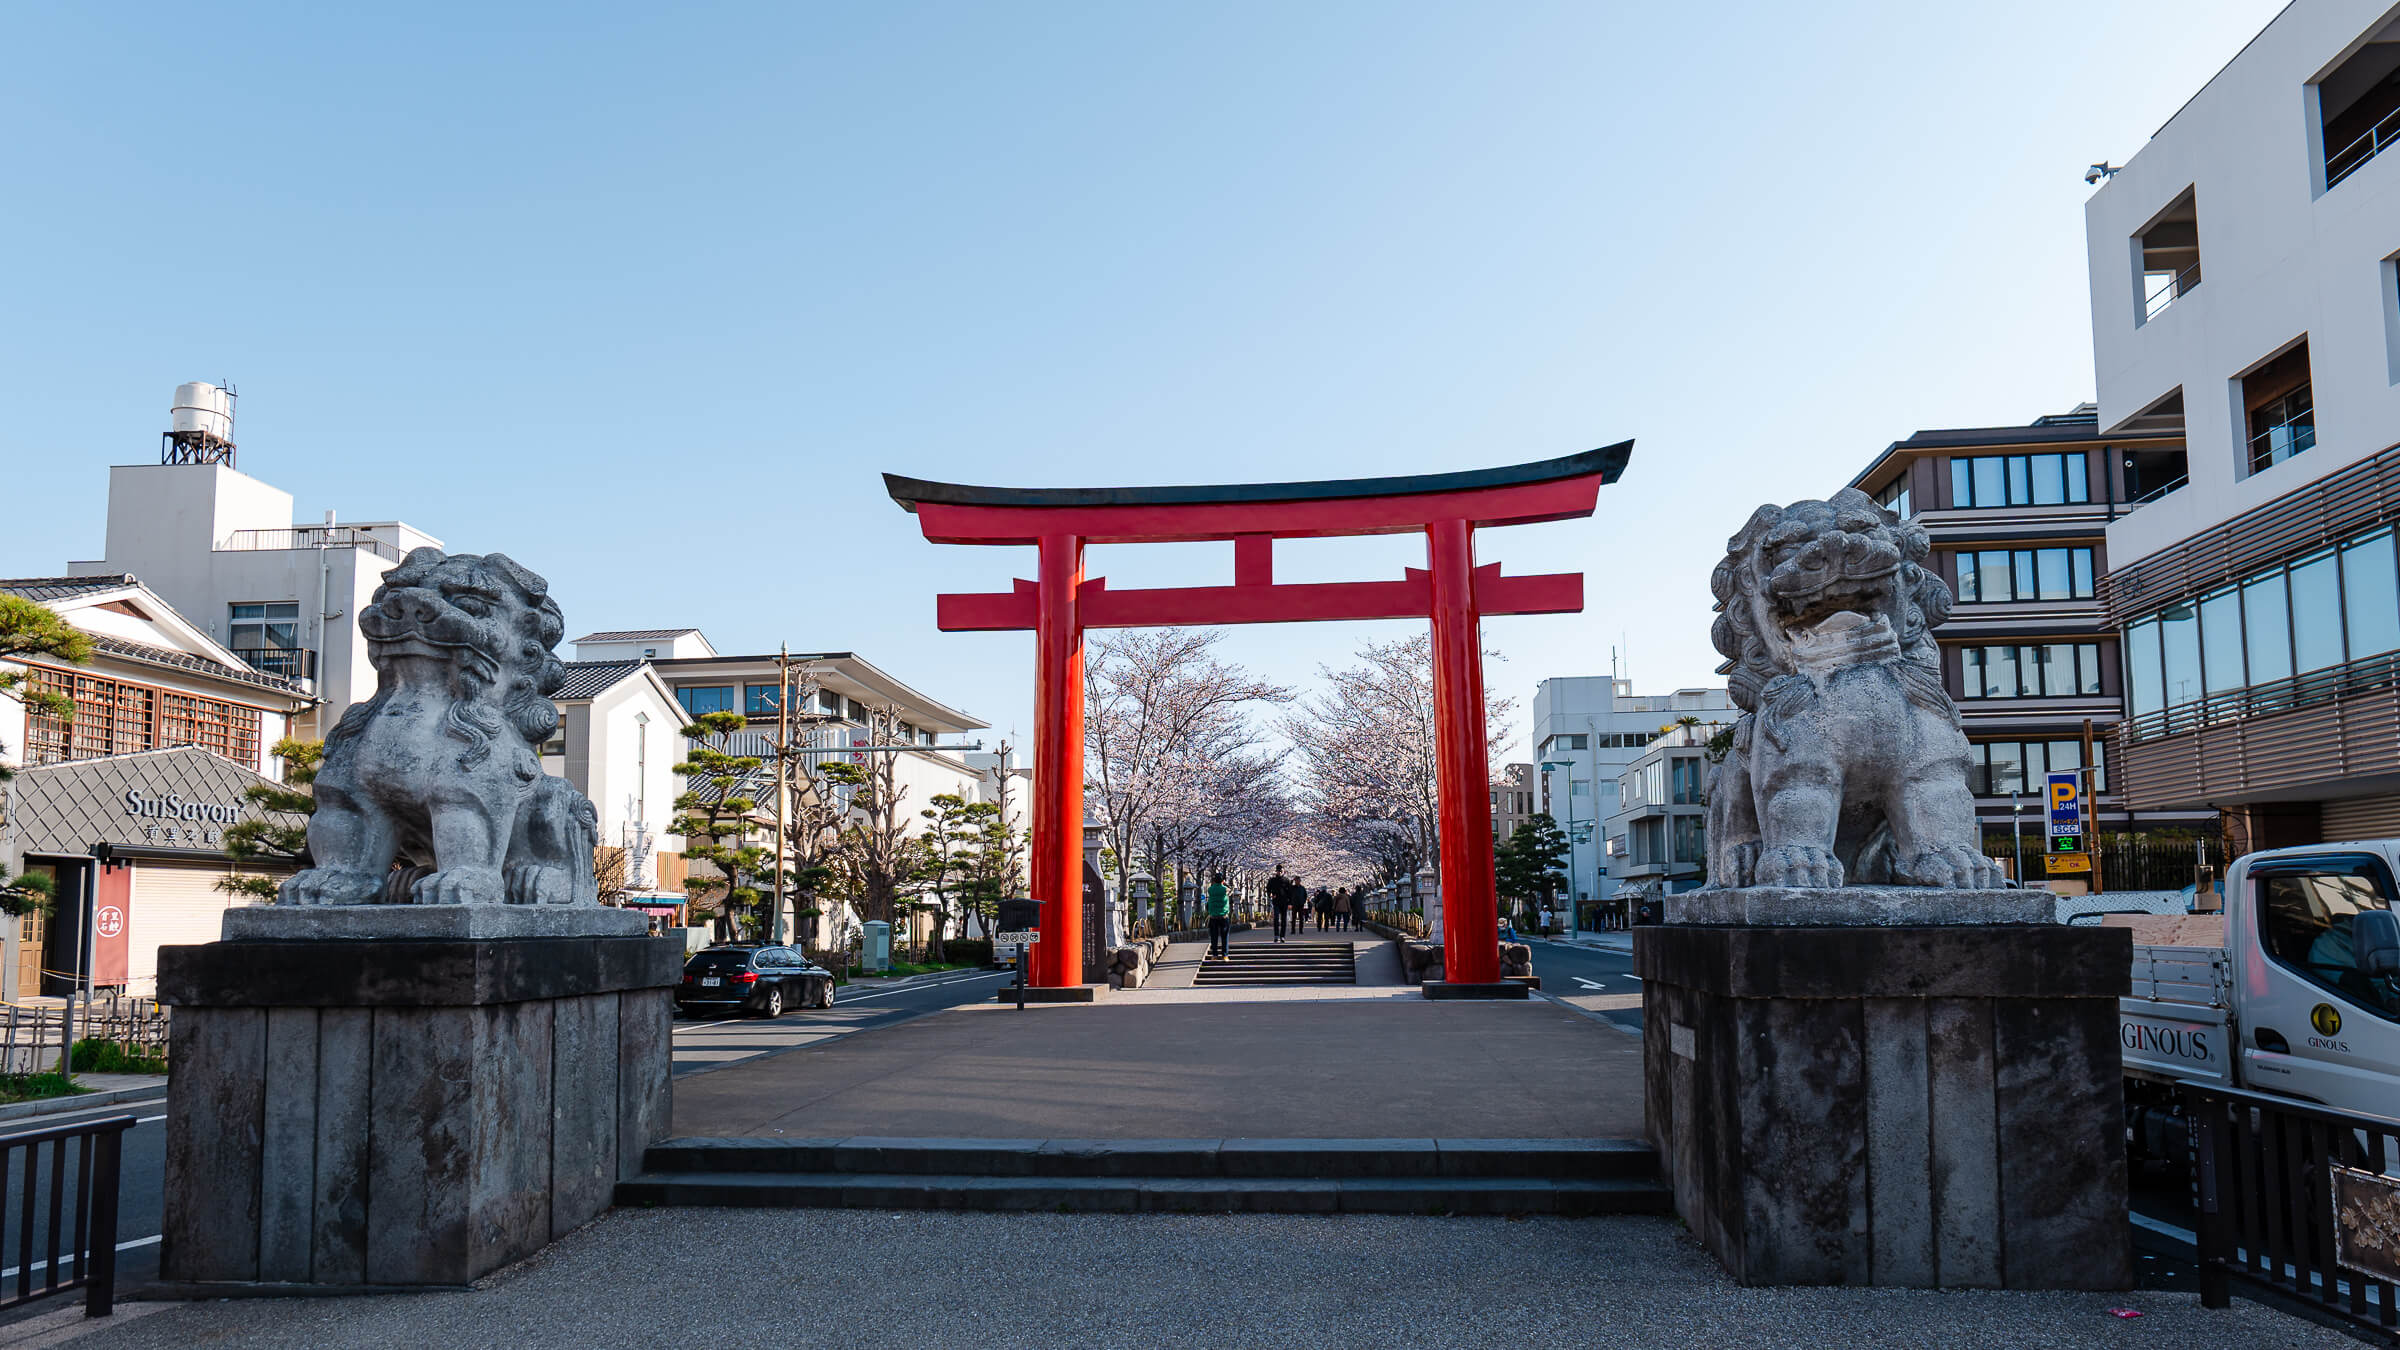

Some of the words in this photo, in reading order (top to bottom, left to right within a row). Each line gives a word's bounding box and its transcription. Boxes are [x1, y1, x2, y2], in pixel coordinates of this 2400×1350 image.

[2051, 783, 2076, 810] P
[2059, 802, 2077, 810] 24H
[2056, 825, 2077, 833] SCC
[2058, 837, 2074, 850] 空
[2121, 1022, 2208, 1061] GINOUS
[2308, 1037, 2348, 1052] GINOUS
